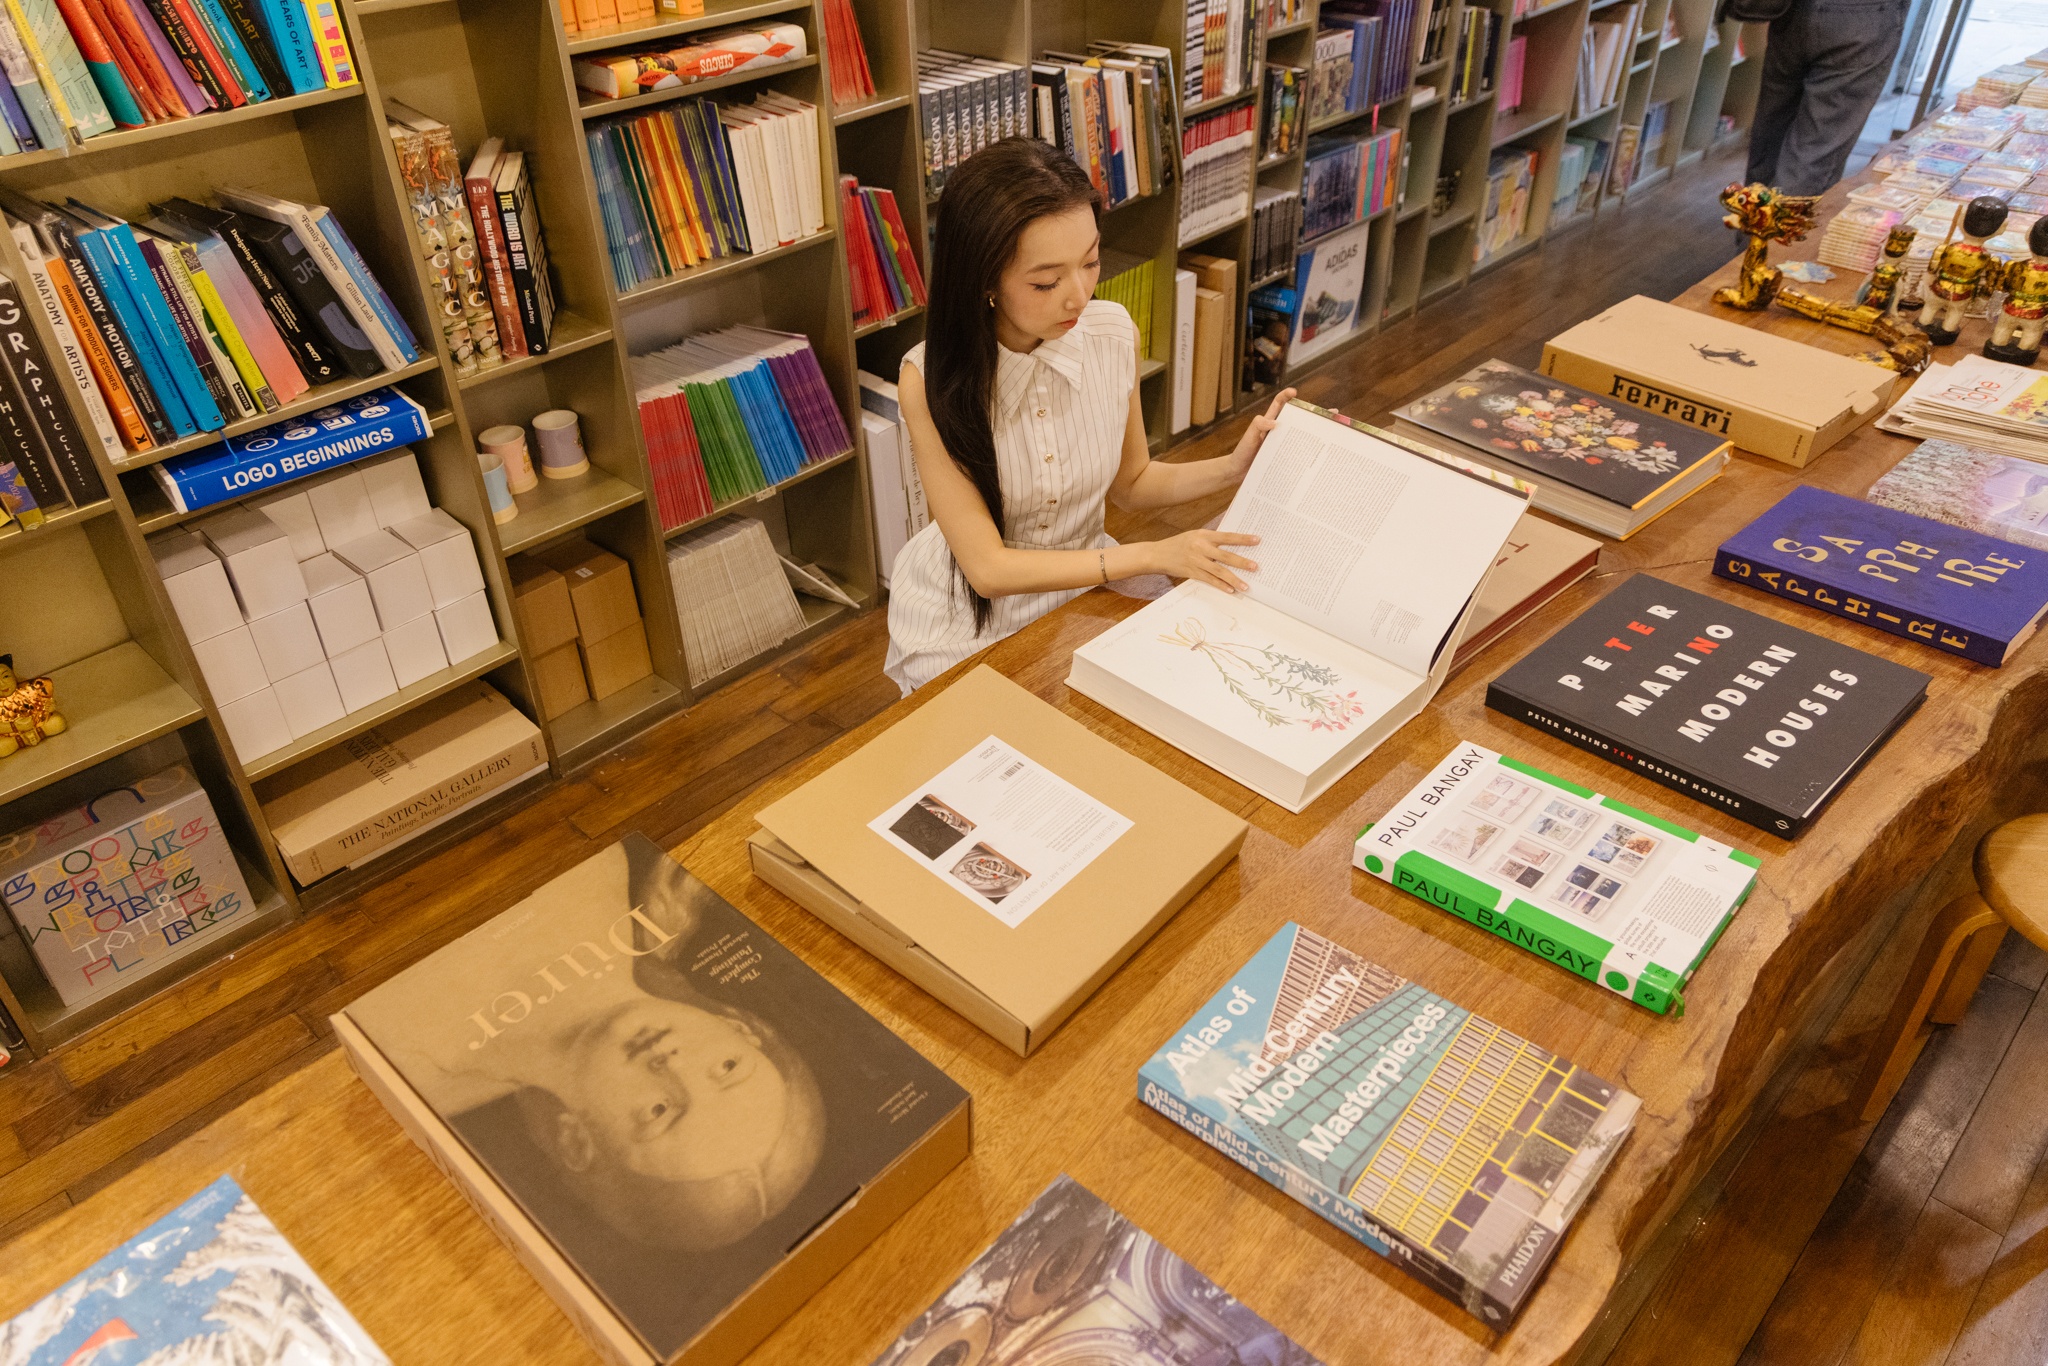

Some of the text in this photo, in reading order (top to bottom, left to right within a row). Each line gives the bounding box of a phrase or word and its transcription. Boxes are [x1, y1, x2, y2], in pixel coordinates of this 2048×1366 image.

[201, 11, 225, 48] Third Dimension
[208, 2, 223, 23] Book
[288, 29, 309, 70] OF ART
[700, 54, 734, 73] CIRCUS
[932, 116, 943, 172] MONET
[228, 228, 274, 291] Designing Here/Now
[298, 213, 340, 272] Family Matters
[323, 221, 340, 244] Unfolding
[418, 201, 462, 317] MAGIC
[442, 193, 486, 308] MAGIC
[479, 204, 509, 308] THE HOLLYWOOD HISTORY OF ART
[498, 192, 527, 272] THE WORD IS ART
[1325, 244, 1358, 270] ADIDAS
[163, 252, 204, 322] COLORS FOR ARTISTS
[168, 249, 194, 292] THE FINEST
[292, 257, 320, 284] JR
[346, 257, 355, 267] The
[352, 266, 363, 279] Paper
[359, 278, 367, 287] Art
[364, 285, 372, 295] and
[369, 293, 382, 310] Science
[381, 313, 396, 332] Matthew
[31, 270, 91, 390] ANATOMY ARTISTS
[68, 255, 106, 316] ANATOMY
[102, 321, 133, 370] MOTION
[150, 266, 191, 343] DYNAMIC STILL LIFE FOR ARTISTS
[158, 264, 198, 340] DYNAMIC STILL LIFE FOR ARTISTS
[201, 282, 225, 317] Complete
[220, 314, 234, 334] Book
[344, 281, 364, 306] Gillian
[358, 303, 375, 323] Laub
[522, 288, 536, 325] Michael Petry
[61, 283, 119, 392] DRAWING FOR PRODUCT DESIGNERS
[137, 329, 152, 348] Japan
[145, 347, 170, 381] Typography
[166, 321, 180, 340] Japan
[174, 339, 197, 373] Typography
[204, 379, 218, 401] SEDWICK
[212, 375, 226, 398] SEDWICK
[236, 388, 250, 409] PRESTEL
[1609, 375, 1732, 434] Ferrari
[59, 434, 86, 487] CLASSICS
[222, 427, 394, 491] LOGO BEGINNINGS
[1876, 495, 1996, 537] DESIGNING WITH FLOWERS
[1727, 560, 1970, 650] SAPPHIRE
[1558, 604, 1679, 691] PETER
[1615, 624, 1734, 717] MARINO
[1677, 644, 1798, 743] MODERN
[1743, 669, 1859, 769] HOUSES
[370, 763, 393, 786] THE
[1528, 711, 1741, 808] PETER MARINO TEN MODERN HOUSES
[338, 755, 512, 850] THE NATIONAL GALLERY
[381, 818, 419, 840] Paintings,
[448, 785, 482, 806] Portraits
[1377, 749, 1485, 847] PAUL BANGAY
[689, 927, 749, 976] Selected Drawings
[695, 932, 731, 962] and Prints
[1398, 870, 1465, 916] PAUL
[1476, 907, 1595, 974] BANGAY
[1622, 925, 1640, 945] global survey
[1633, 918, 1655, 943] most exceptional
[1635, 928, 1656, 951] unbuilt projects
[467, 902, 680, 1052] Dürer
[706, 939, 753, 983] Paintings
[717, 947, 762, 989] Complete
[739, 967, 762, 985] The
[1161, 985, 1258, 1078] Atlas of
[1214, 963, 1365, 1113] Mid-Century
[1438, 1013, 1462, 1038] Bradbury
[1240, 1030, 1342, 1128] Modern
[1297, 1001, 1447, 1164] Masterpieces
[1143, 1091, 1262, 1172] Masterpieces
[1144, 1080, 1418, 1260] Atlas of Mid-Century Modern
[1499, 1225, 1548, 1288] PHAIDON
